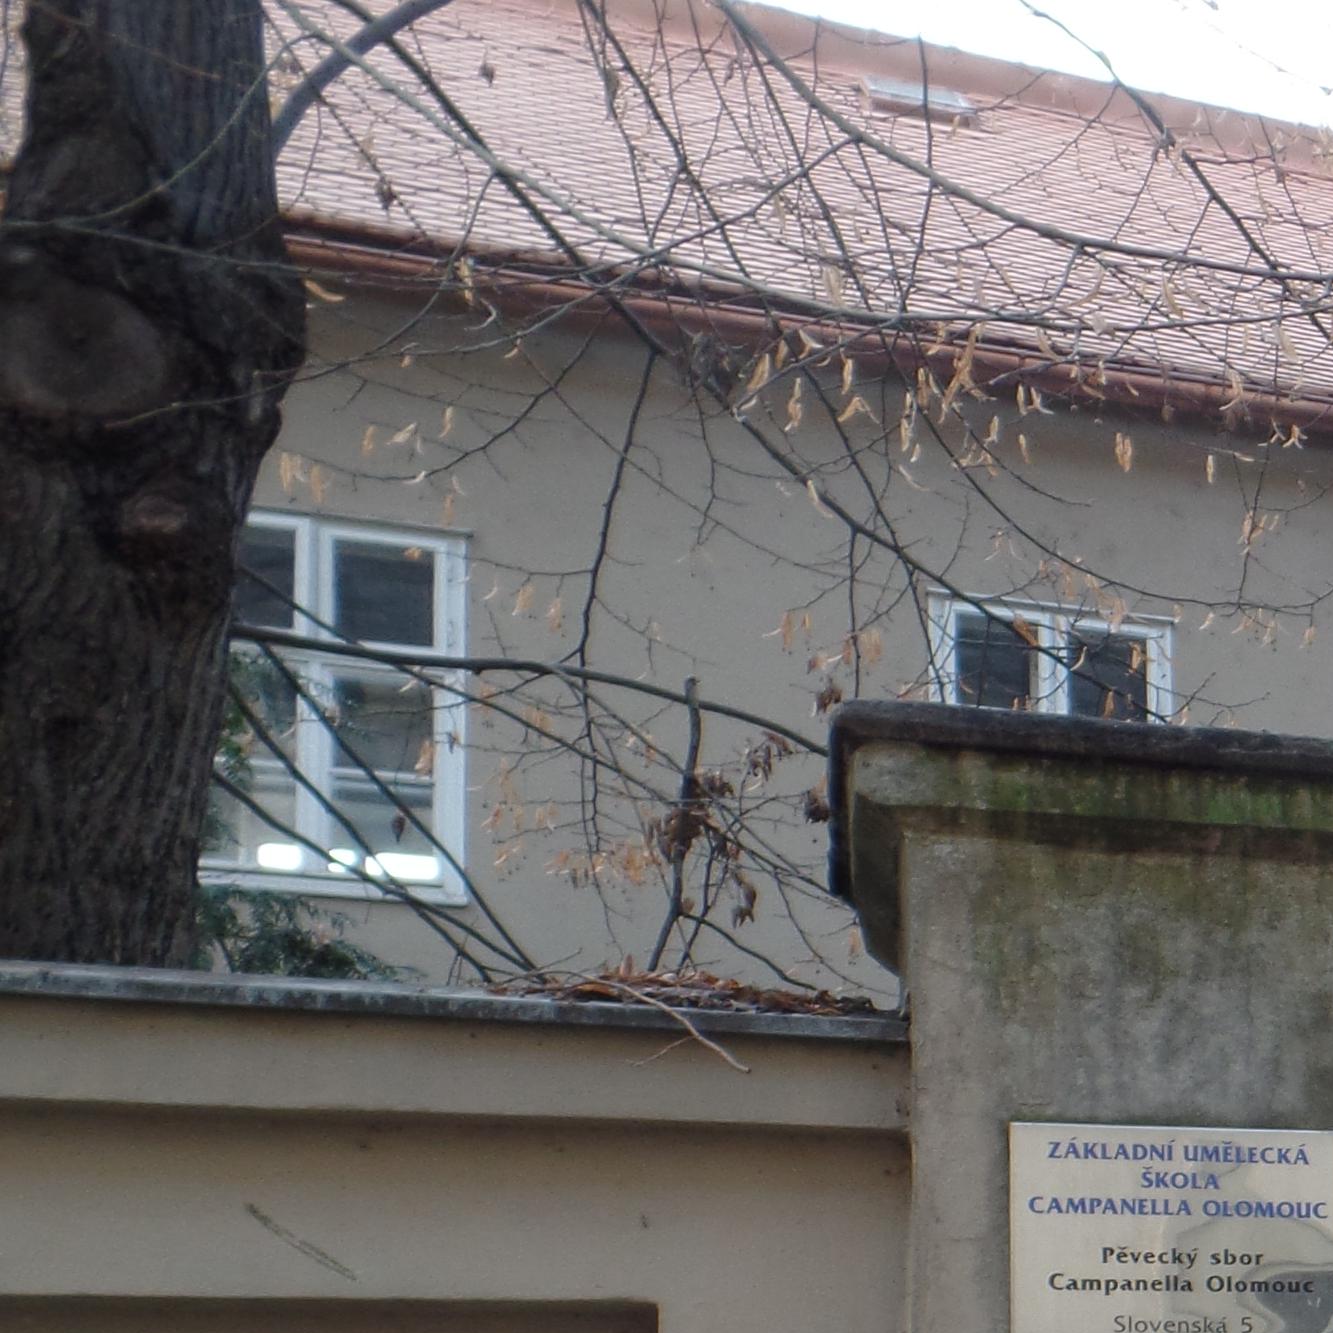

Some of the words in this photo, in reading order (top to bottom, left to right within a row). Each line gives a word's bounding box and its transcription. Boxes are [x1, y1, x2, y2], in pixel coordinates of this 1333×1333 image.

[1048, 1136, 1175, 1160] ZÁKLADNÍ
[1184, 1141, 1309, 1165] UMĚLECKÁ
[1140, 1166, 1220, 1189] ŠKOLA
[1028, 1196, 1192, 1216] CAMPANELLA
[1203, 1200, 1328, 1219] OLOMOUC
[1101, 1246, 1198, 1269] Pěvecký
[1210, 1248, 1264, 1265] sbor
[1048, 1273, 1193, 1295] Campanella
[1206, 1275, 1315, 1293] Olomouc
[1114, 1315, 1227, 1333] Slovenská
[1241, 1316, 1253, 1333] 5
